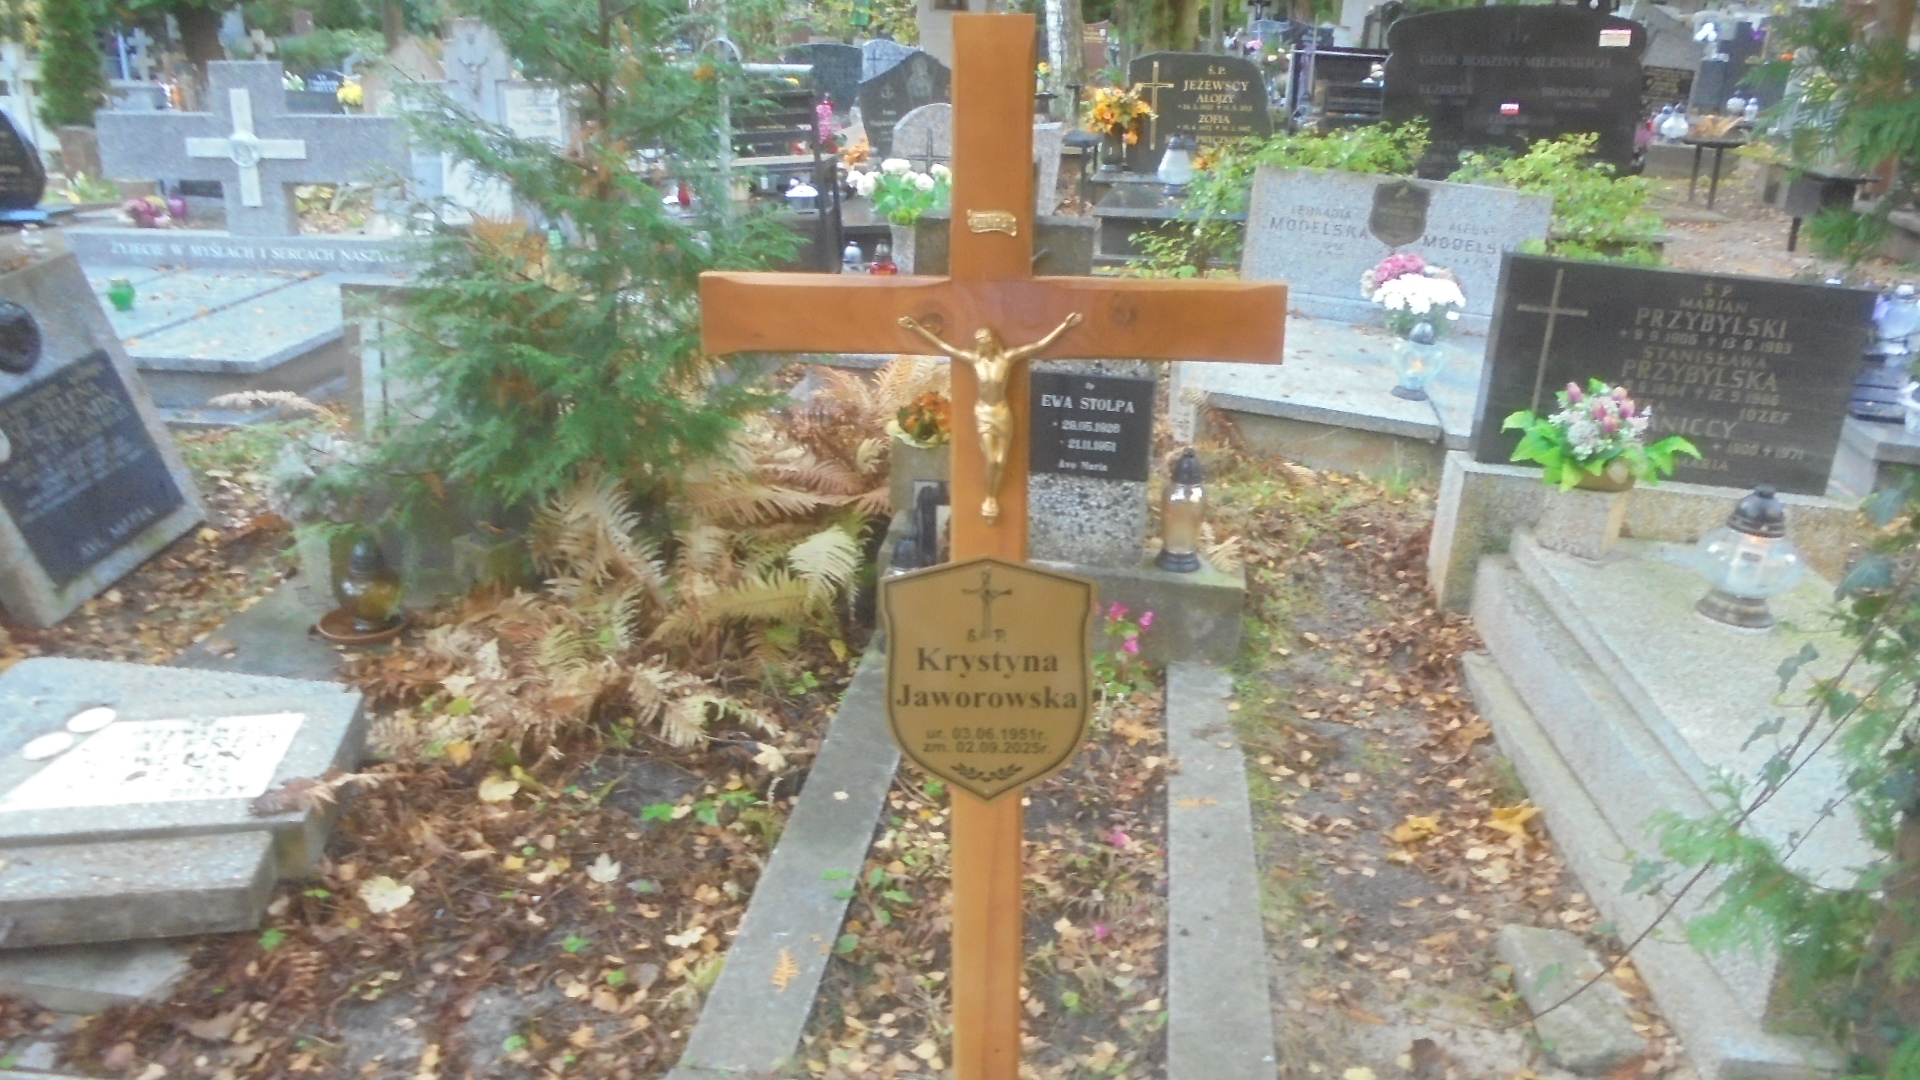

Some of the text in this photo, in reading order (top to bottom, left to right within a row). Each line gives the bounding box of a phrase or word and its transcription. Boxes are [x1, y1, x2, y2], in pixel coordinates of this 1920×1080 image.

[1183, 78, 1250, 92] JEŻEWSCY
[1196, 94, 1235, 104] ALOJZY
[1198, 114, 1231, 124] ZOFIA
[1679, 297, 1749, 313] MARIAN
[1635, 307, 1788, 339] PRZYBYLSKI
[1643, 345, 1768, 369] STANISŁAWA
[1621, 359, 1779, 392] PRZYBYLSKA
[1041, 394, 1135, 414] EWA STOLPA
[916, 646, 1059, 679] Krystyna
[896, 684, 1078, 709] Jaworowska
